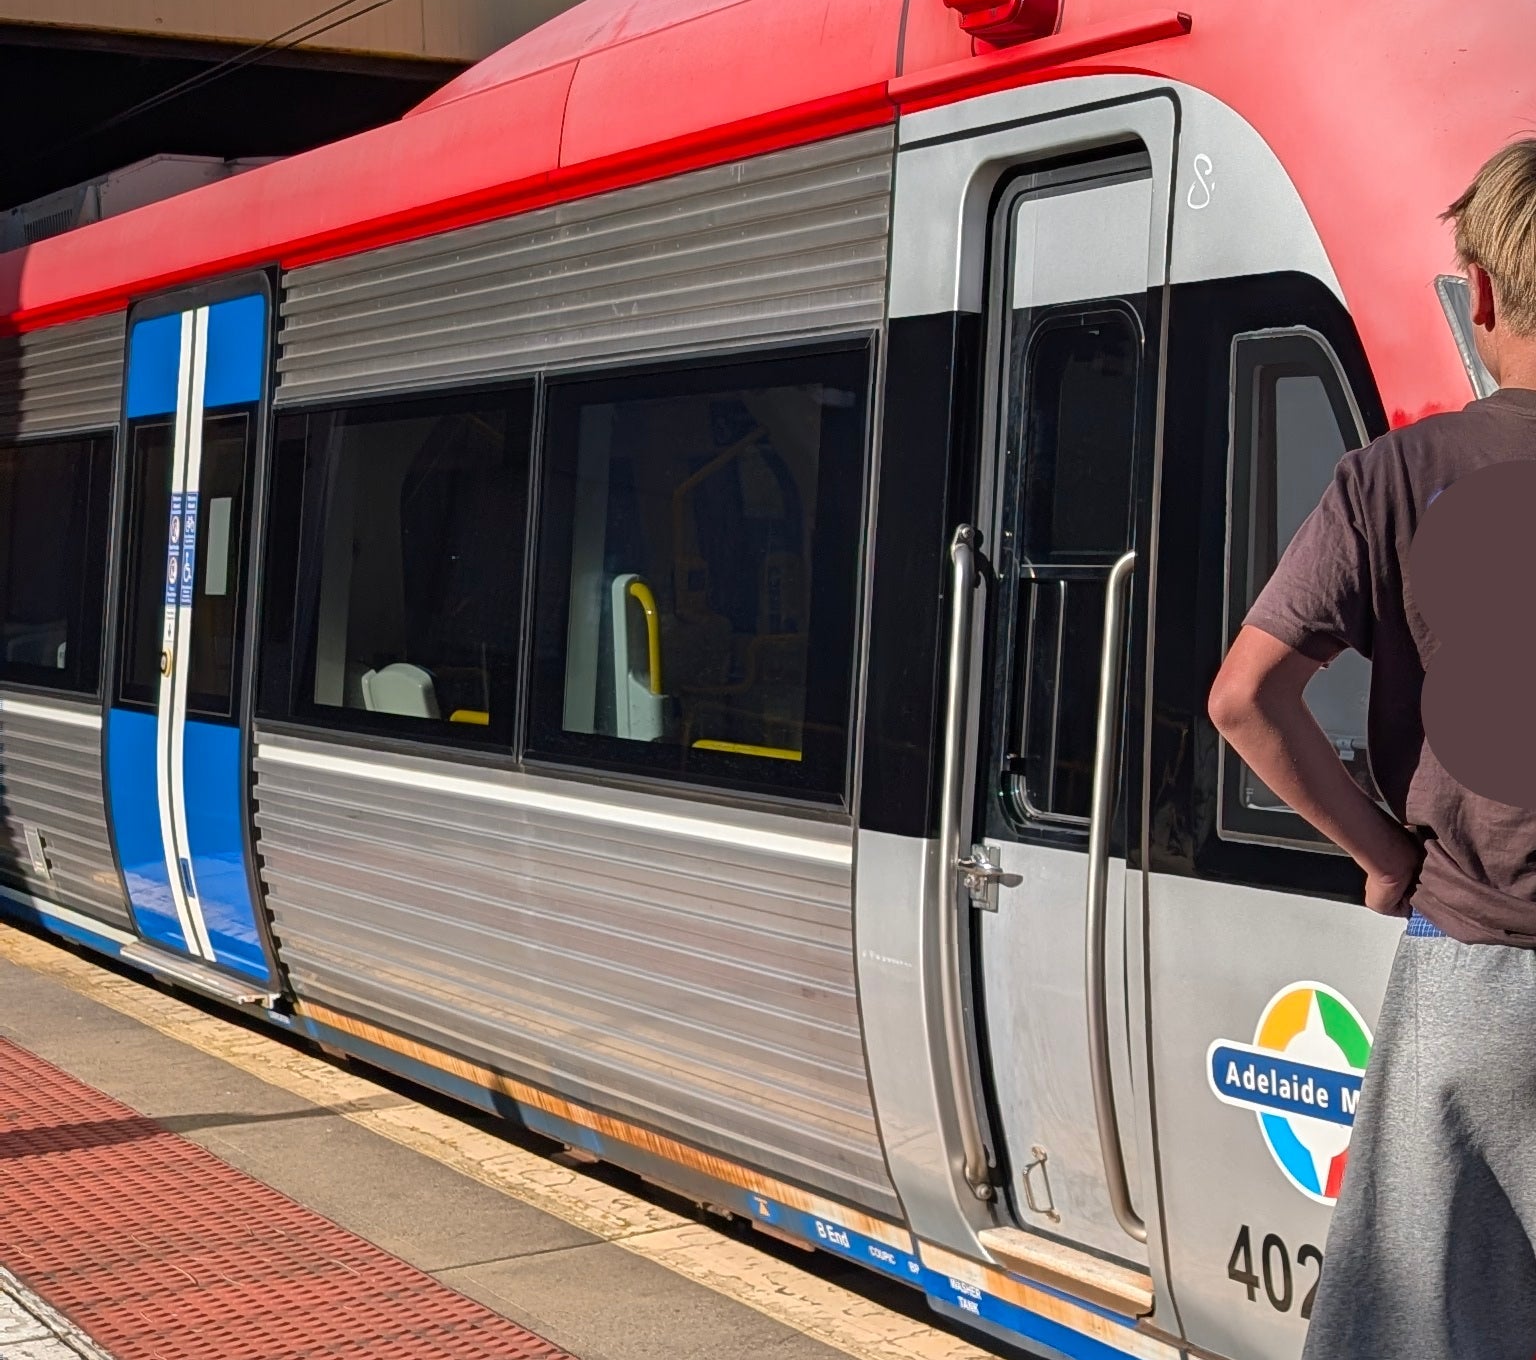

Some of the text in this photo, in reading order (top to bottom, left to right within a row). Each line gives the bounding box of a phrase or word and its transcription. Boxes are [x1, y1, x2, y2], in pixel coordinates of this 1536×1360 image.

[1225, 1060, 1329, 1110] Adelaide
[815, 1220, 850, 1249] B End
